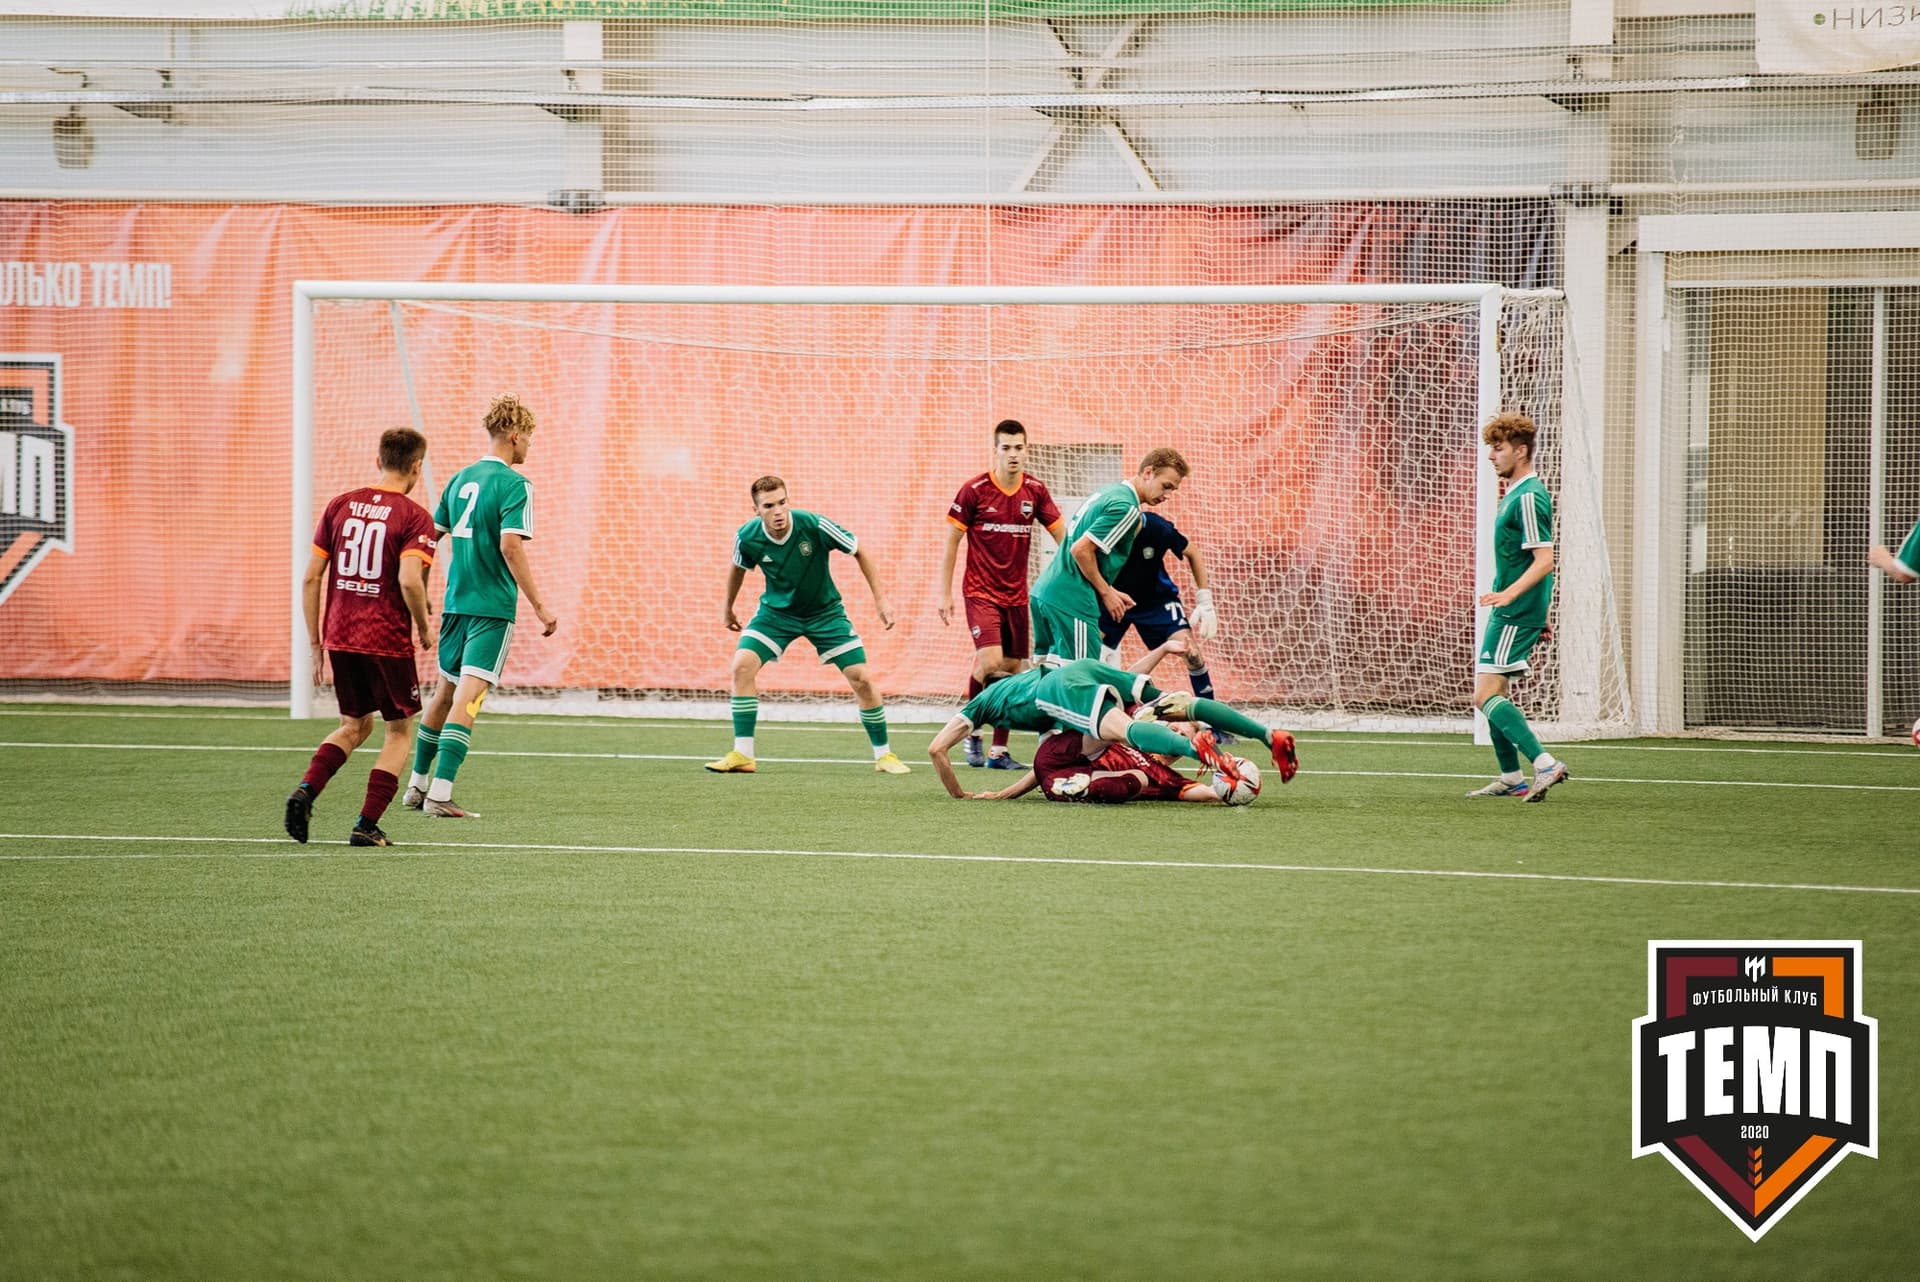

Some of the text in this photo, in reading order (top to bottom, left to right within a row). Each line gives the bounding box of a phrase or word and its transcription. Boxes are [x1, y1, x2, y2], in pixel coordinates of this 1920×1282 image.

[90, 262, 172, 309] ТЕМП!
[349, 501, 393, 521] ЧЕРНОВ
[452, 482, 480, 538] 2
[338, 518, 387, 580] 30
[336, 580, 381, 594] SEUS
